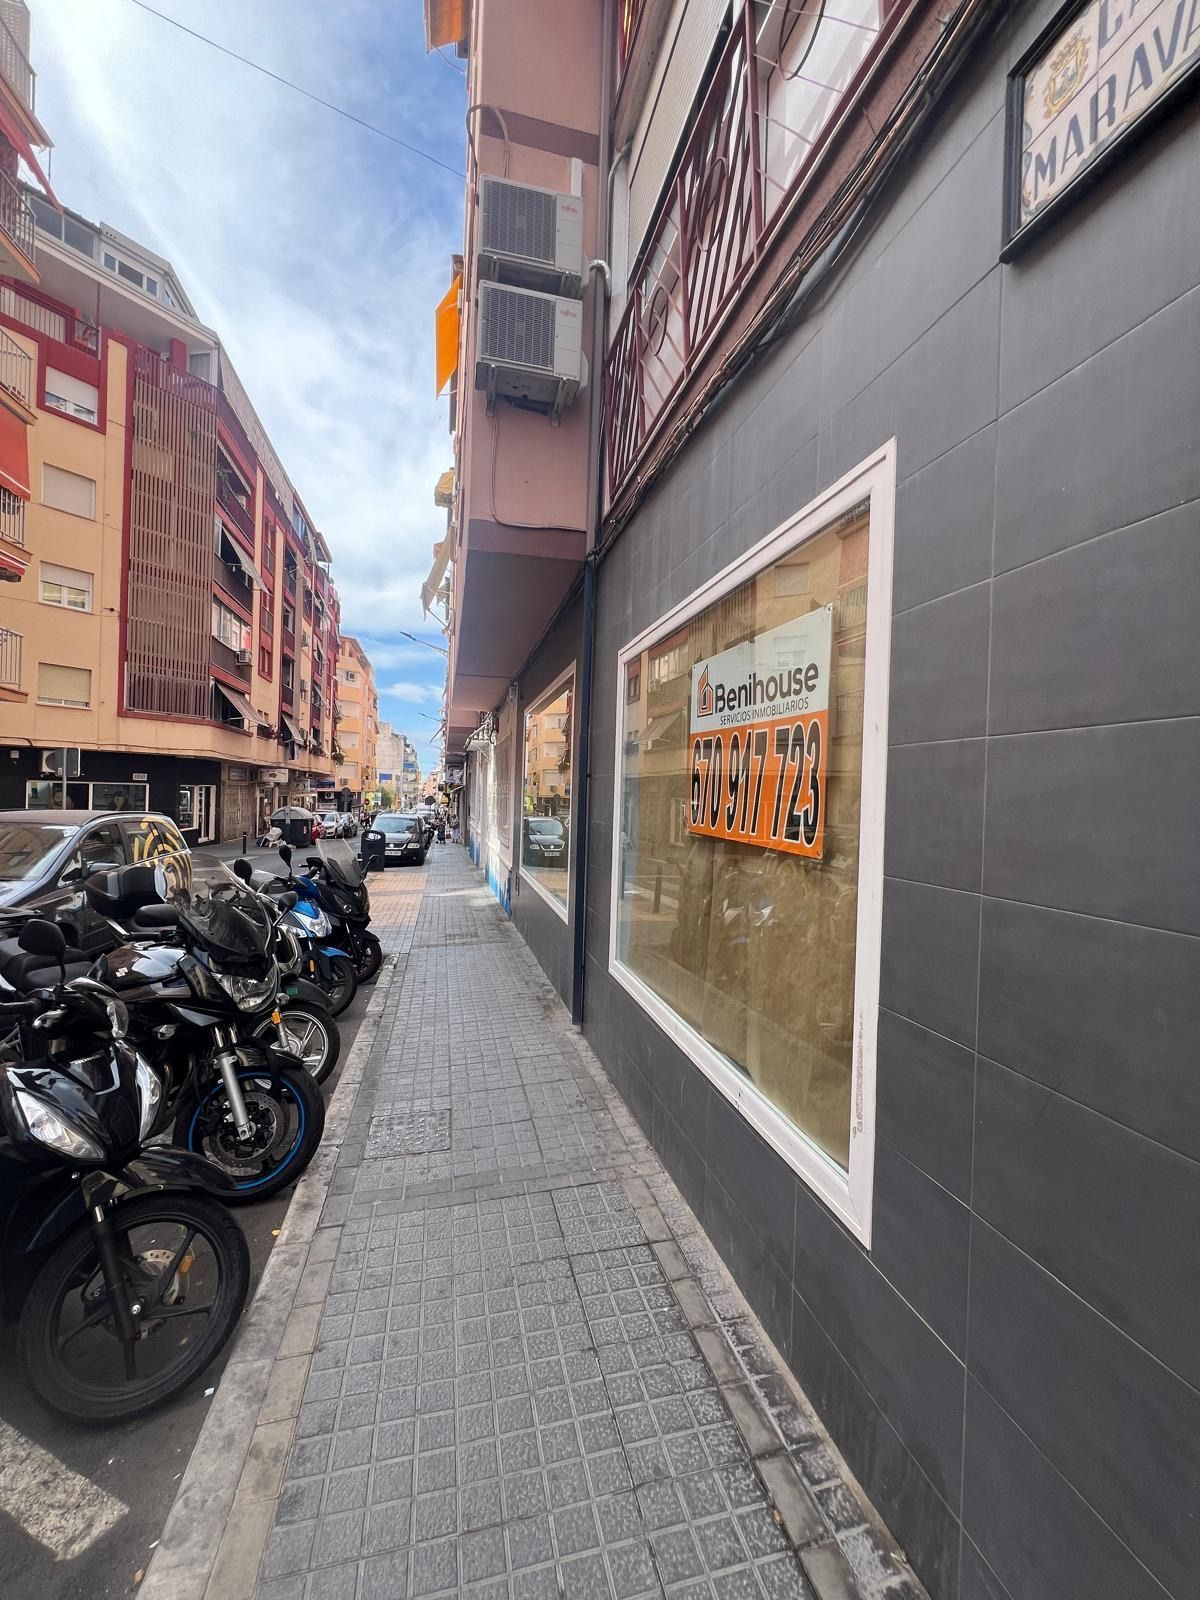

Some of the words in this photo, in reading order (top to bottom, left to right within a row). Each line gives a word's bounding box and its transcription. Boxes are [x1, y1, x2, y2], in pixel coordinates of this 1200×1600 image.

[714, 662, 819, 713] Benihouse
[720, 710, 751, 726] SERVICIOS
[751, 696, 809, 720] INMOBILIARIOS
[691, 734, 724, 830] 670
[725, 728, 769, 836] 917
[770, 719, 822, 848] 723
